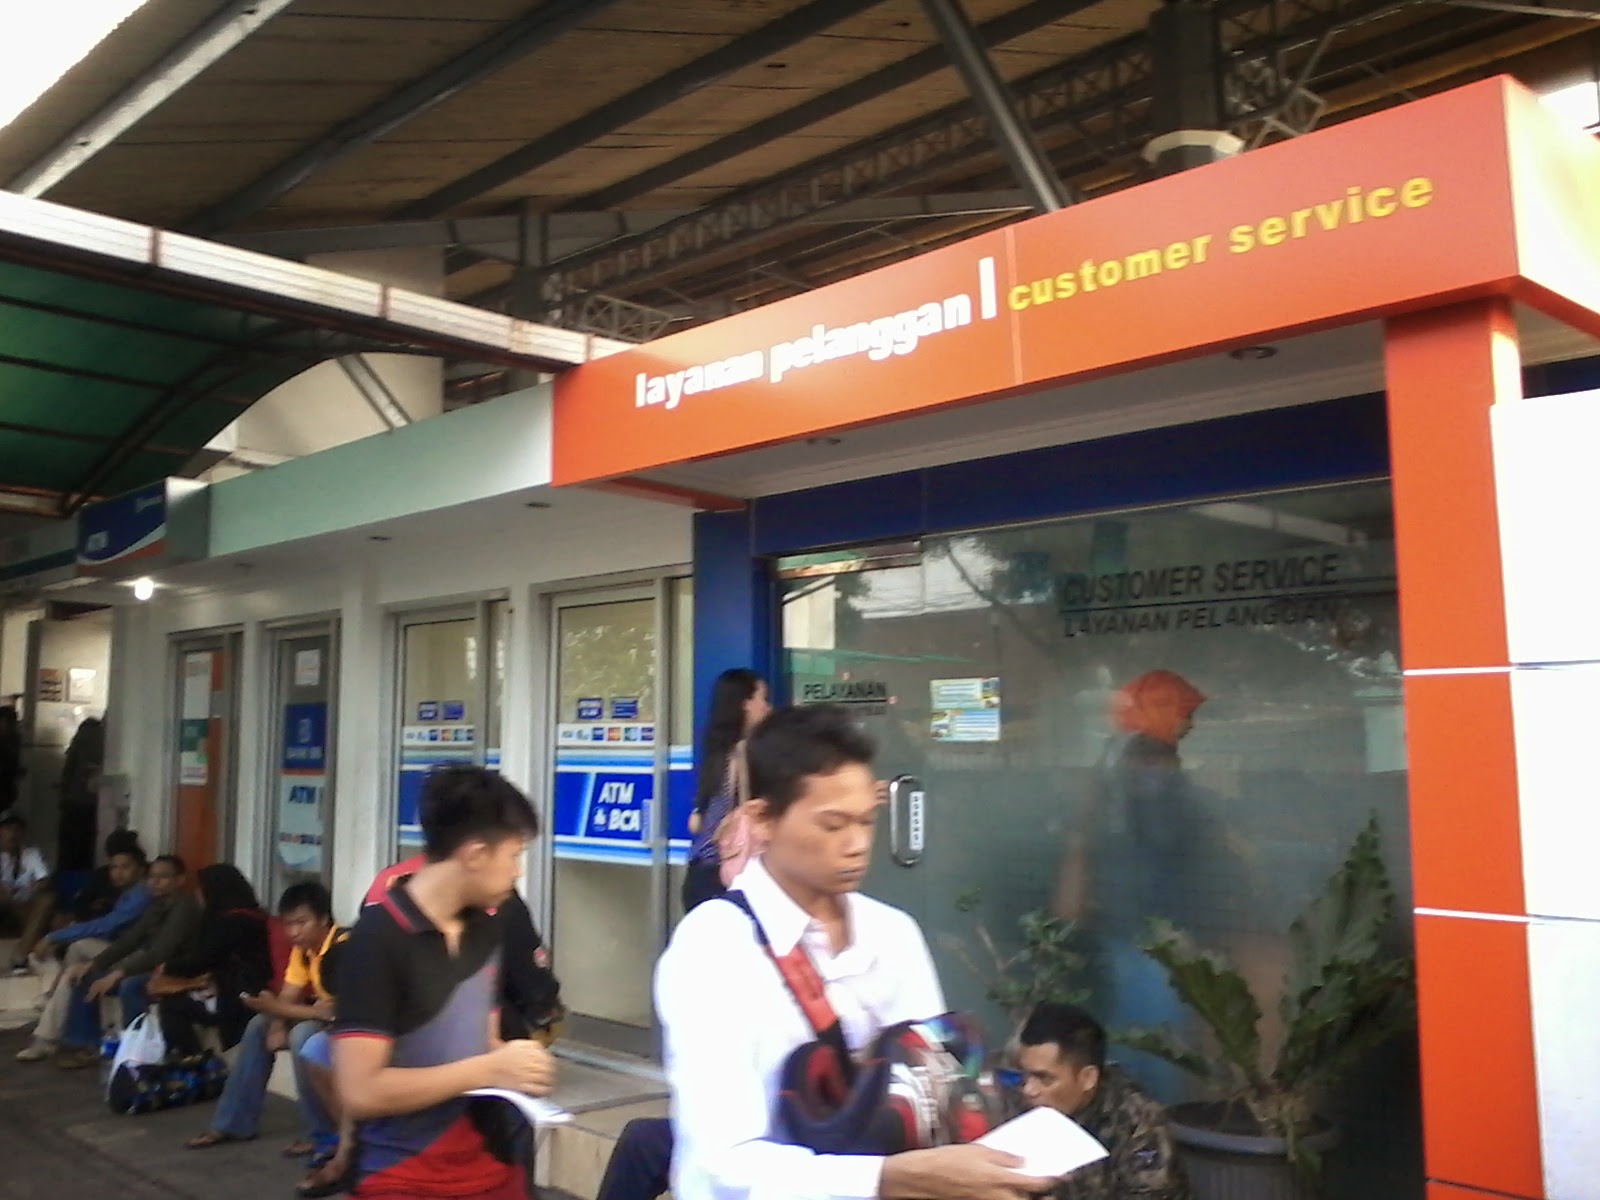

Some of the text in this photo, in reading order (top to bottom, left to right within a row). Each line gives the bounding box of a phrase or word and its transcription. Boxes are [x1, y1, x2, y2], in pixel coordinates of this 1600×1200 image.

[635, 176, 1434, 409] layanan pelanggan customer service
[1064, 554, 1340, 605] CUSTOMER SERVICE
[1064, 600, 1341, 638] LAYANAN PELANGGAN
[598, 782, 635, 805] ATM
[608, 808, 641, 832] BCA
